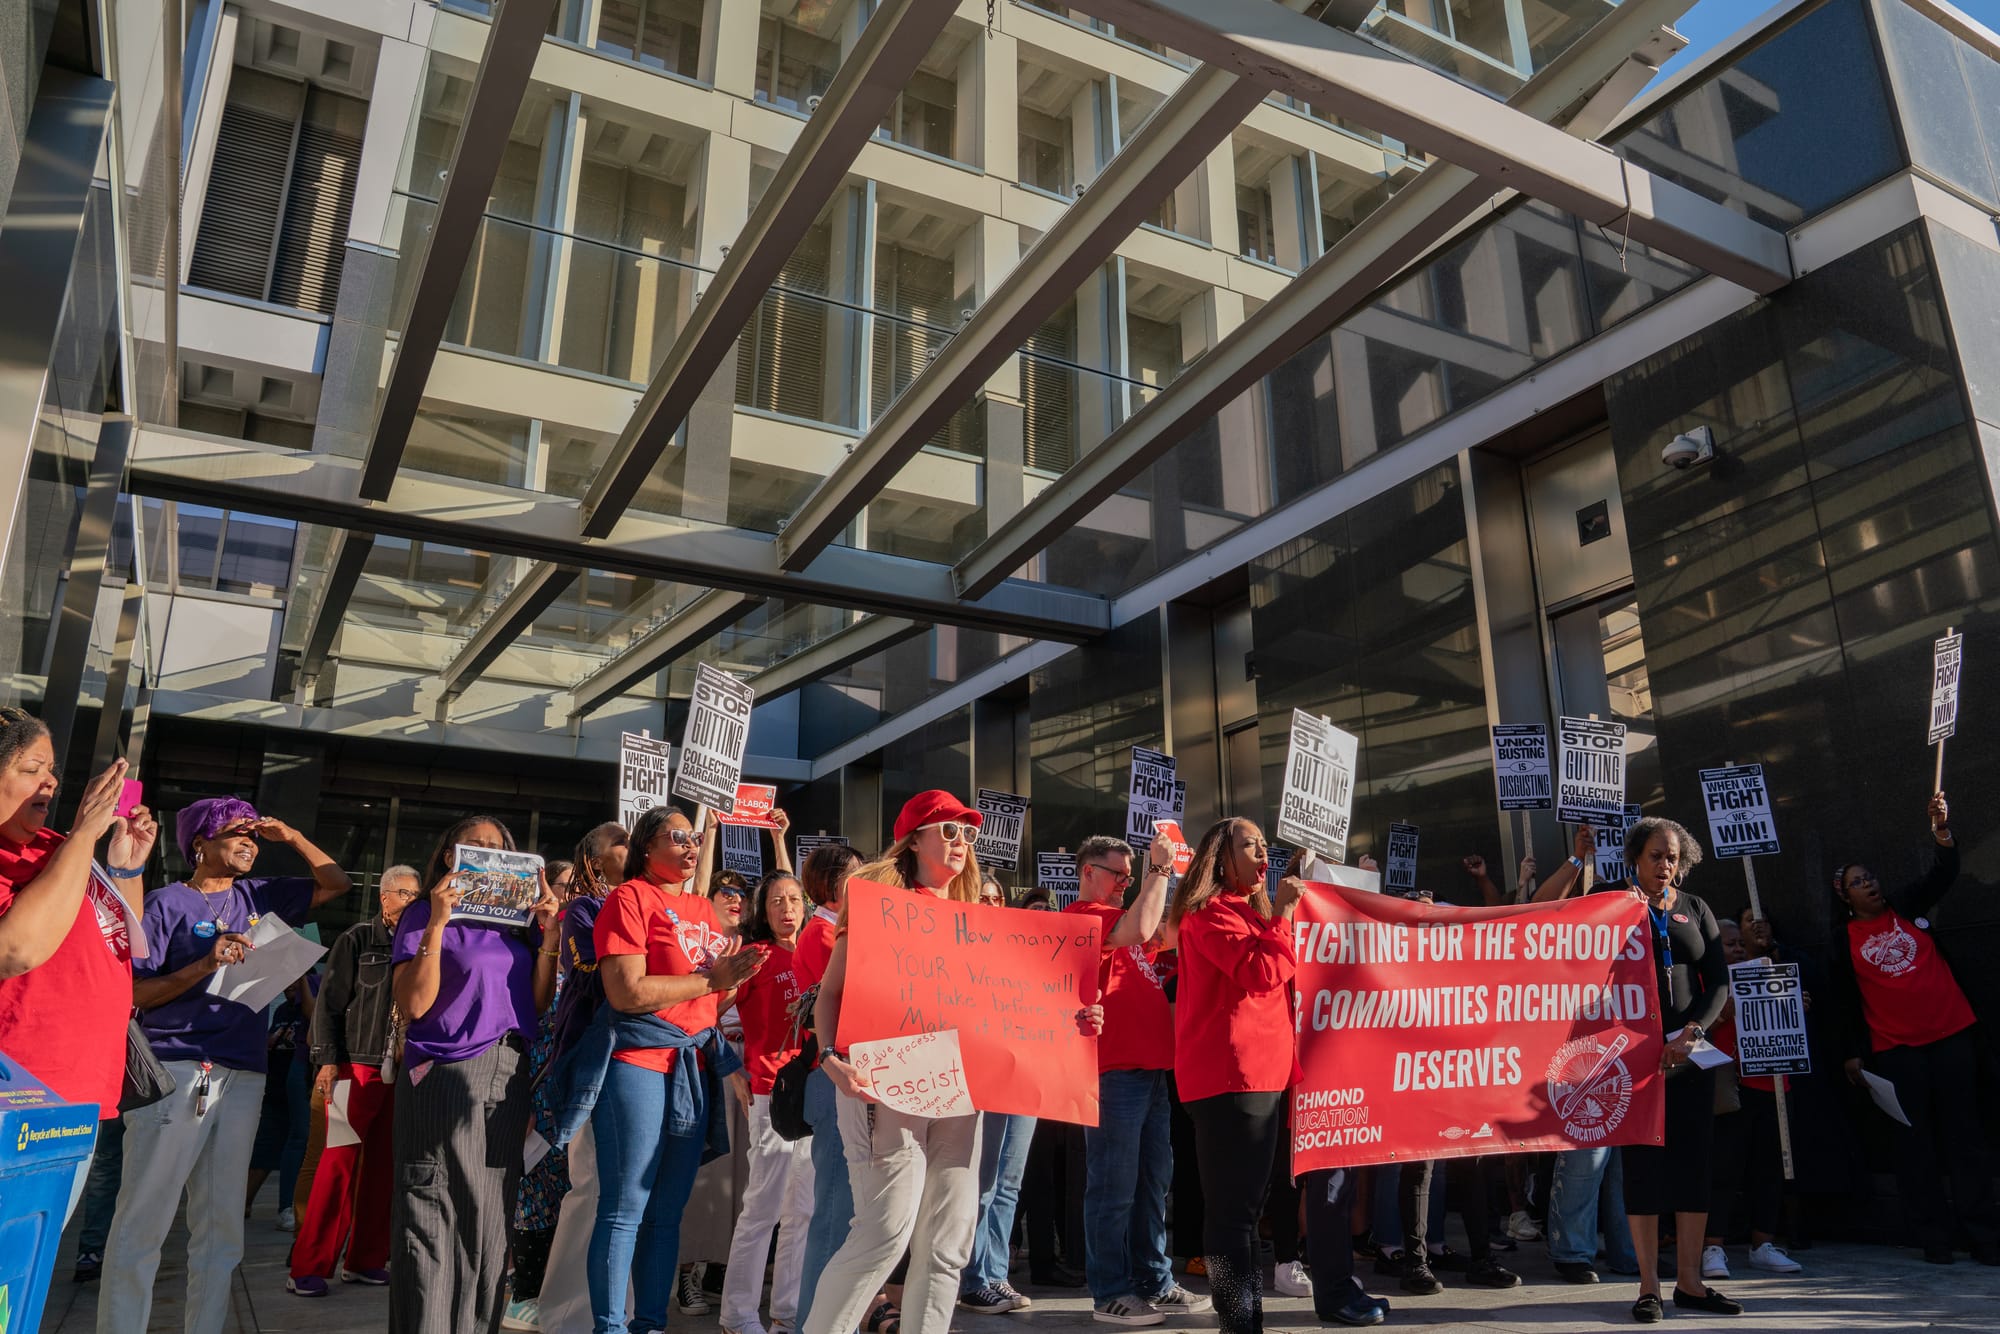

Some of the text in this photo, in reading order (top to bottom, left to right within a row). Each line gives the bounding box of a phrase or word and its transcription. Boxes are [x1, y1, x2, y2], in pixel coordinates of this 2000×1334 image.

[1936, 649, 1959, 666] WHEN WE
[1936, 662, 1959, 689] FIGHT
[696, 683, 749, 717] STOP
[1934, 700, 1954, 726] WIN!
[691, 706, 743, 762] GUTTING
[1496, 737, 1545, 747] UNION
[1562, 733, 1623, 749] STOP
[1293, 729, 1344, 764] STO
[1498, 747, 1545, 760] BUSTING
[625, 750, 650, 768] WHEN
[652, 756, 664, 771] WE
[683, 748, 739, 782] COLLECTIVE
[1136, 761, 1172, 781] WHEN WE
[1518, 763, 1527, 771] IS
[1566, 750, 1619, 785] GUTTING
[623, 765, 666, 796] FIGHT
[682, 762, 735, 794] BARGAINING
[1132, 774, 1173, 802] FIGHT
[1292, 751, 1349, 808] GUTTING
[1499, 774, 1550, 798] DISGUSTING
[1706, 777, 1760, 792] WHEN WE
[638, 798, 650, 810] WE
[734, 798, 769, 809] TI-LABOR
[1561, 784, 1623, 802] COLLECTIVE
[1562, 796, 1621, 811] BARGAINING
[1708, 787, 1764, 811] FIGHT
[978, 800, 1024, 815] STOP
[1148, 802, 1158, 813] WE
[1284, 791, 1348, 830] COLLECTIVE
[1732, 812, 1747, 821] WE
[1284, 806, 1344, 840] BARGAINING
[1717, 821, 1768, 844] WIN!
[726, 826, 758, 852] GUTTING
[975, 837, 1019, 852] OLLECTIVE
[1392, 834, 1407, 843] WHEN
[1597, 829, 1626, 847] FIG
[725, 852, 760, 866] COLLECTIVE
[1390, 842, 1416, 859] FIGHT
[726, 861, 760, 874] BARGAINING
[1390, 869, 1412, 885] WIN!
[1041, 881, 1080, 891] ATTACKIN
[462, 903, 518, 918] THIS YOU?
[881, 897, 1099, 961] RPS How many of
[1296, 921, 1646, 965] FIGHTING FOR THE SCHOOLS
[775, 972, 789, 983] THE
[890, 944, 950, 980] YOUR
[1042, 973, 1073, 994] will
[784, 989, 792, 1000] IS
[1735, 980, 1798, 995] STOP
[900, 982, 914, 1001] it
[936, 985, 977, 1009] take
[992, 992, 1049, 1017] before
[1312, 984, 1489, 1031] COMMUNITIES
[1496, 984, 1647, 1023] RICHMOND
[1742, 998, 1799, 1032] GUTTING
[975, 1018, 989, 1035] it
[1003, 1018, 1056, 1043] RIGHT
[1740, 1034, 1805, 1048] COLLECTIVE
[855, 1033, 936, 1068] no due process
[1744, 1045, 1805, 1059] BARGAINING
[870, 1058, 960, 1097] Fascist
[1393, 1047, 1522, 1092] DESERVES
[1296, 1088, 1364, 1111] CHMOND
[1564, 1074, 1632, 1142] EDUCATION ASSOCIATION
[1296, 1106, 1369, 1132] UCATION
[30, 1129, 45, 1142] Recycle
[45, 1130, 50, 1139] at
[51, 1128, 61, 1141] Work,
[62, 1127, 73, 1136] Home
[80, 1124, 93, 1134] School
[1295, 1125, 1382, 1153] SOCIATION
